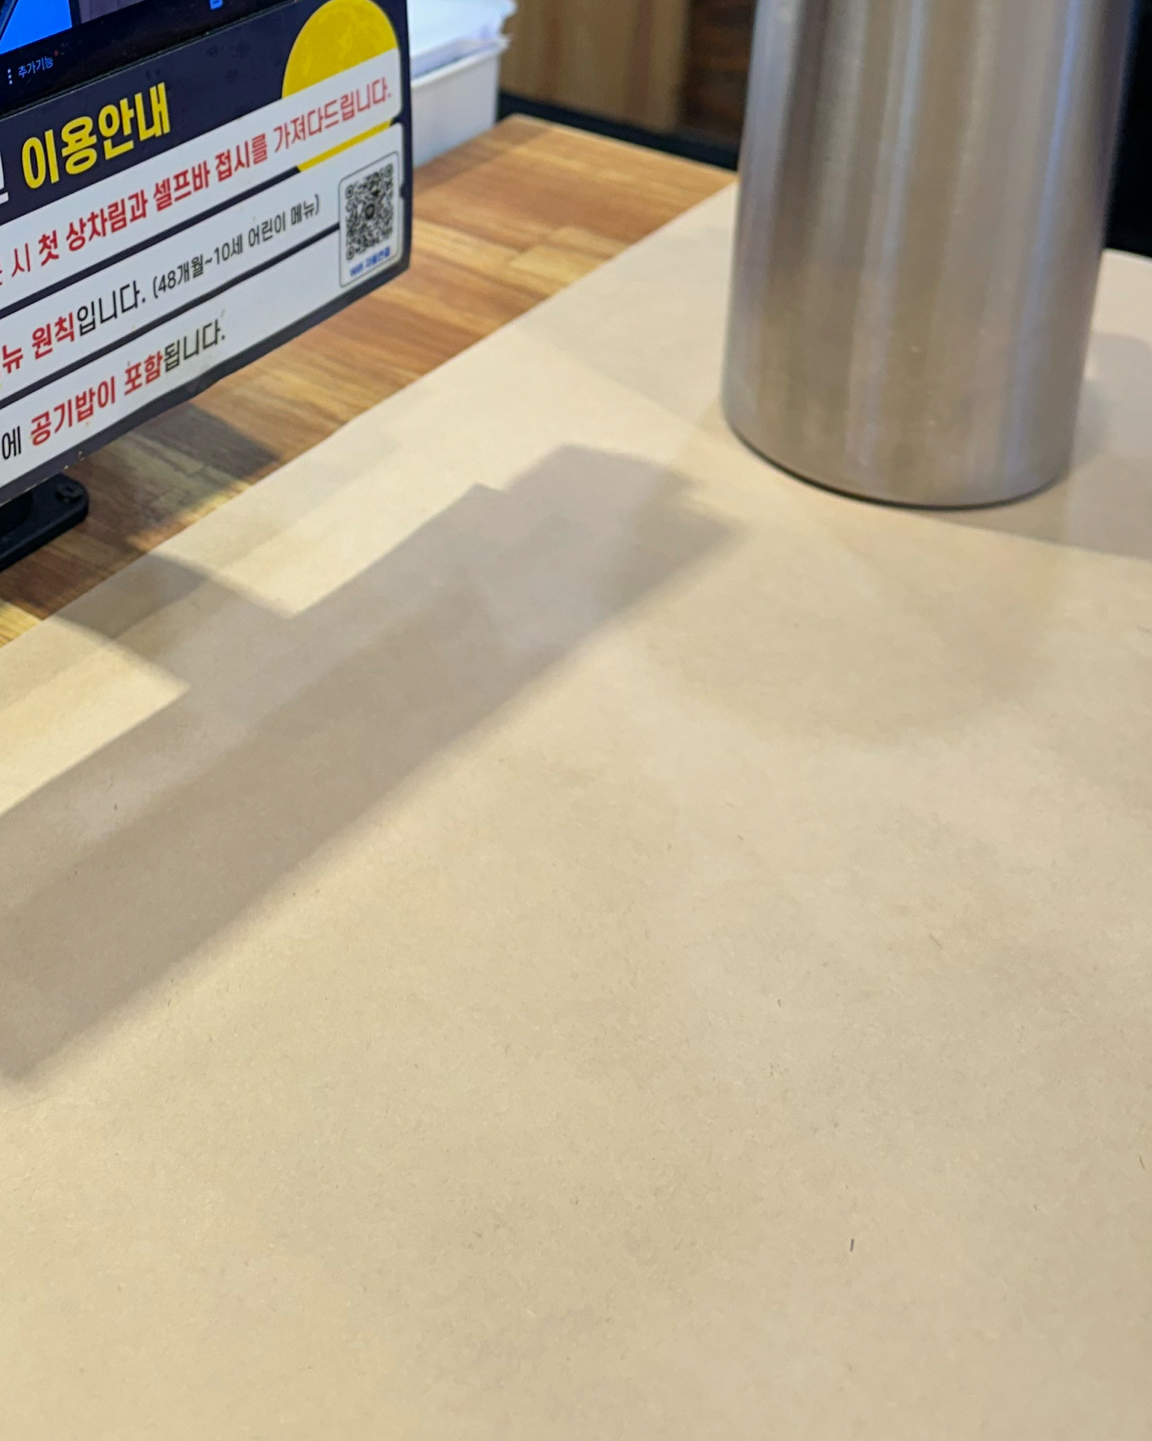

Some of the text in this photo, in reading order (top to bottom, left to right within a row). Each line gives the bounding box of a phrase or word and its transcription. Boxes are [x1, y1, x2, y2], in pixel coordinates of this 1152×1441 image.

[17, 56, 54, 78] 추가기능
[11, 242, 31, 277] 시
[37, 230, 60, 267] 첫
[65, 189, 148, 252] 상차림과
[153, 161, 211, 212] 셀프바
[215, 133, 269, 182] 접시를
[273, 76, 392, 154] 가져다드립니다.
[21, 82, 171, 189] 이용안내
[31, 279, 146, 361] 원칙입니다.
[248, 210, 287, 248] 어린이
[290, 193, 321, 227] 메뉴)
[30, 375, 117, 448] 공기밥이
[122, 318, 227, 396] 포함됩니다.
